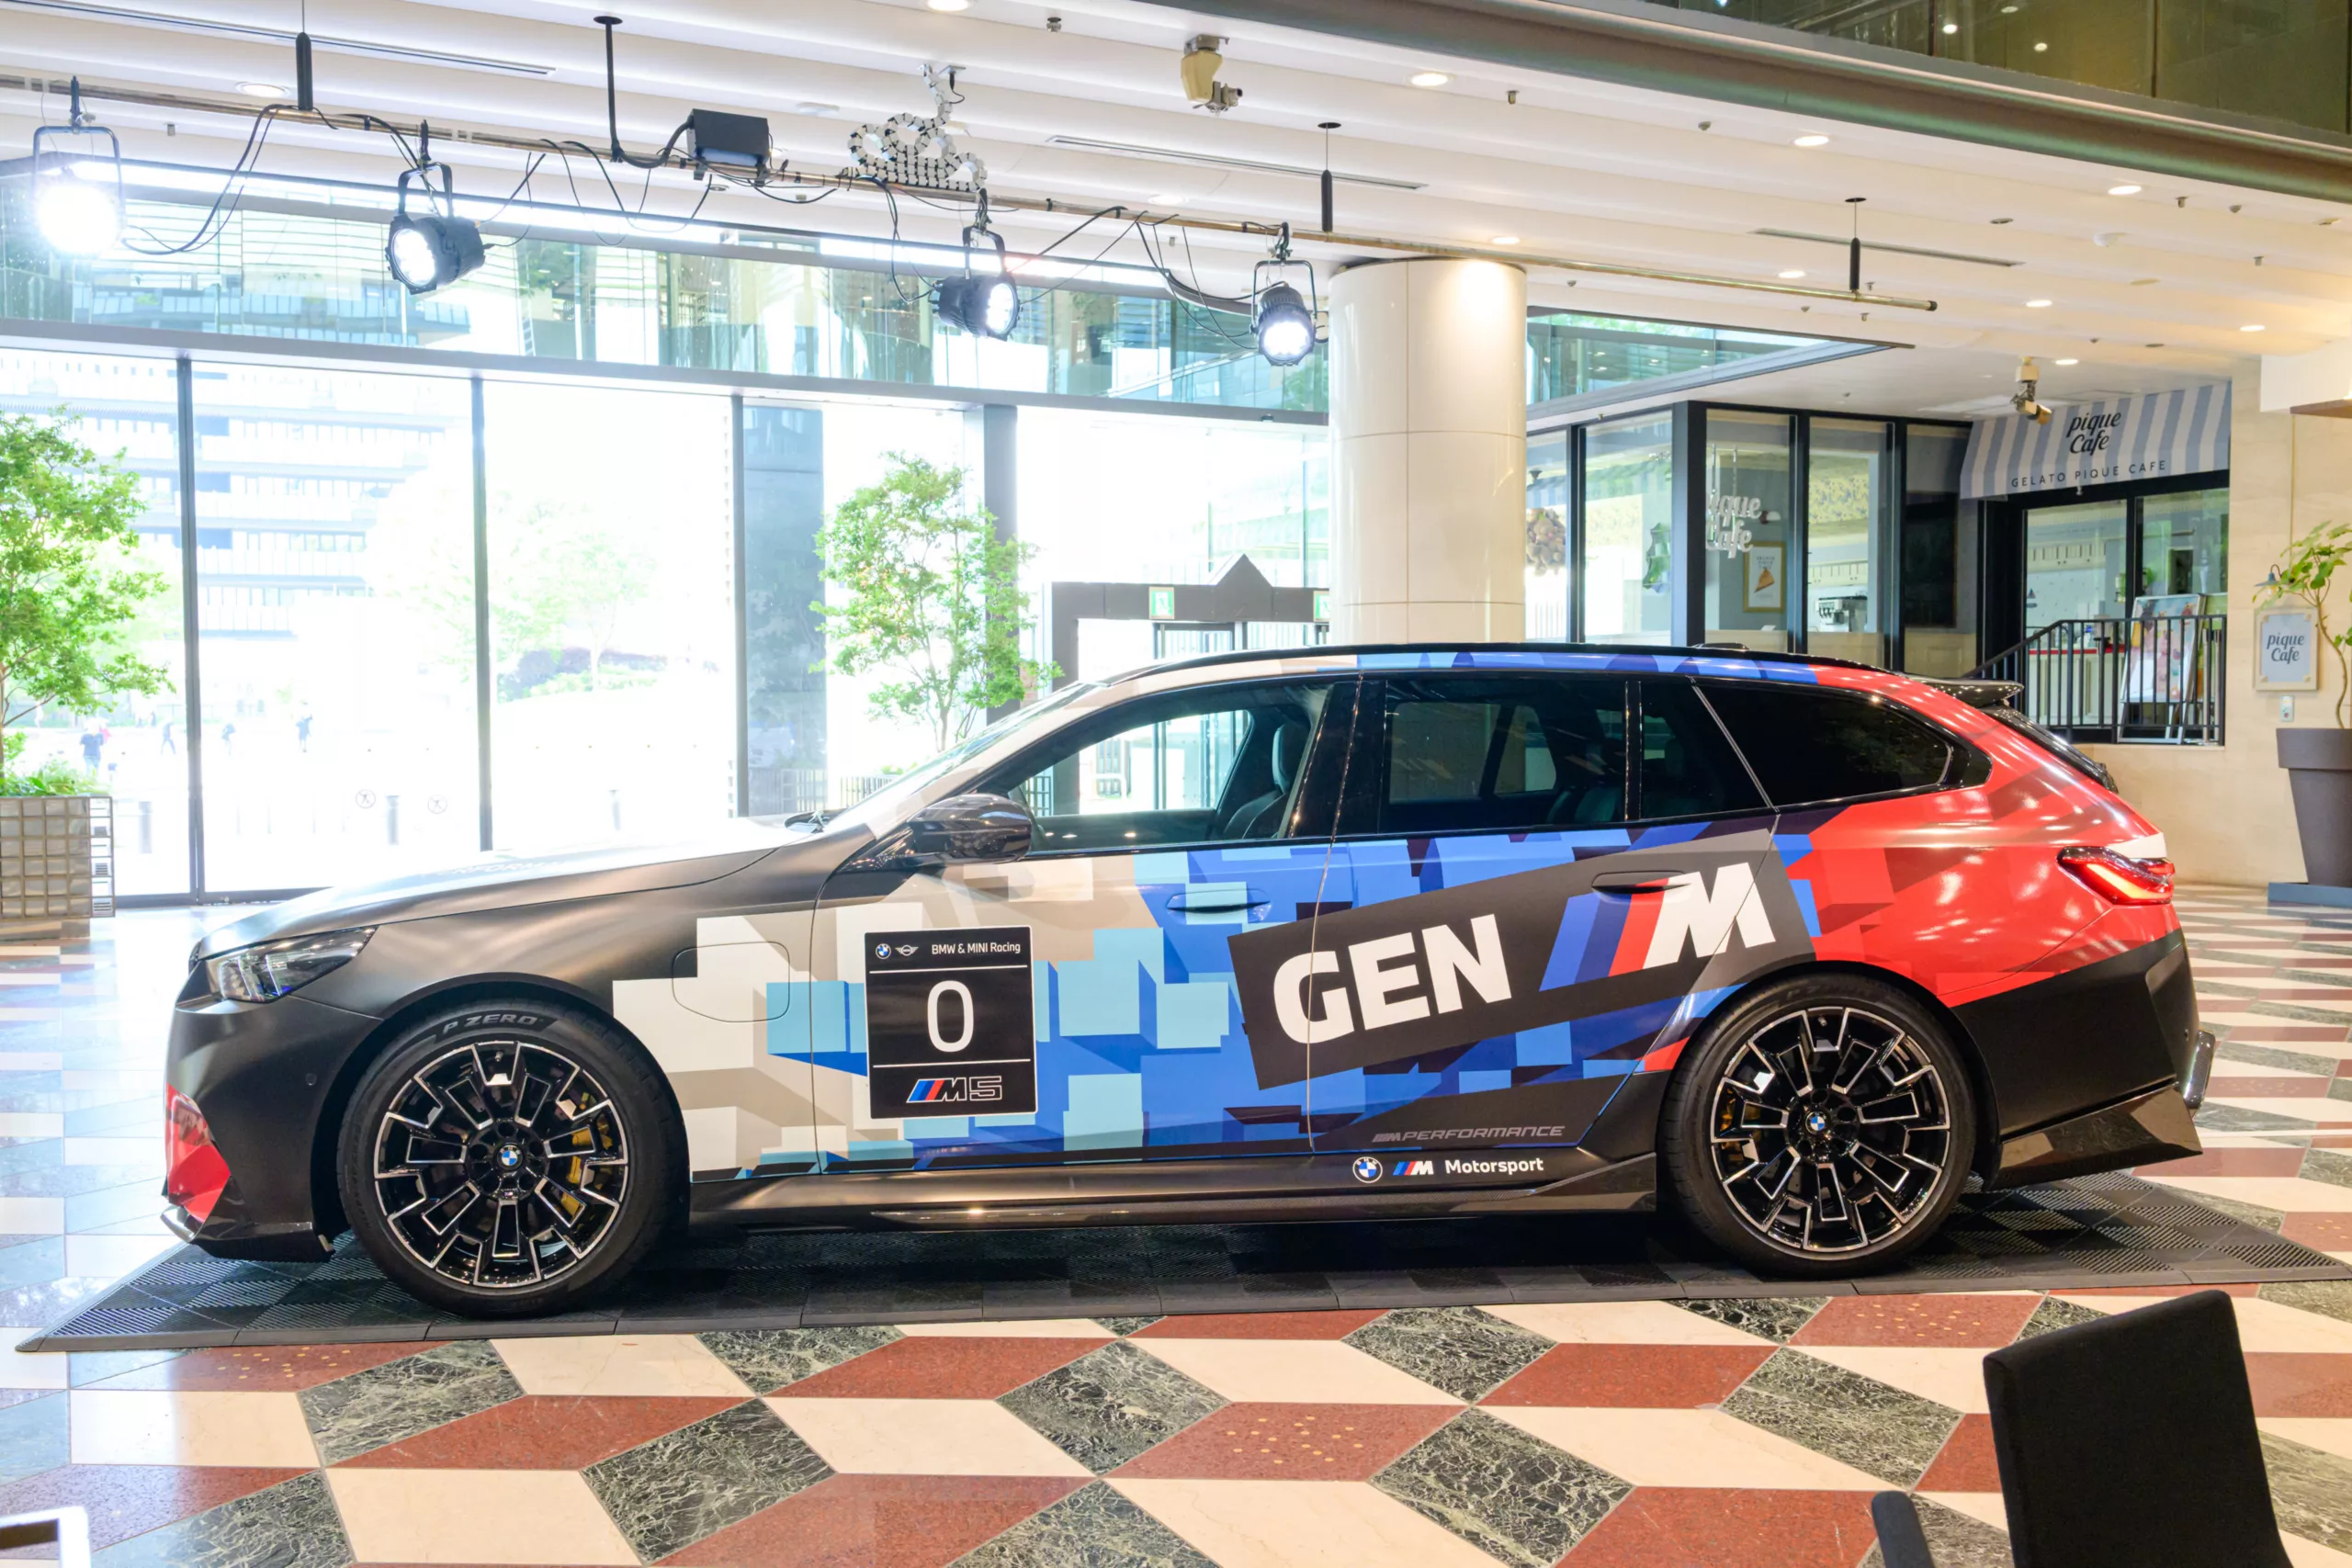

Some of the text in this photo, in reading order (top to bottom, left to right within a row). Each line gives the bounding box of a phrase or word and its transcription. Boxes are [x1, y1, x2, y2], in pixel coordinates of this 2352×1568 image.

[2066, 412, 2121, 438] pique
[2069, 429, 2109, 456] Cafe
[2011, 460, 2165, 488] GELATO PIQUE CAFE
[1706, 489, 1761, 527] ique
[2266, 632, 2305, 649] pique
[2271, 646, 2300, 664] Cafe
[932, 942, 1021, 954] BMW & MINI Racing
[1273, 913, 1511, 1044] GEN
[443, 1014, 538, 1034] P ZERO
[927, 980, 974, 1053] 0
[935, 1076, 1002, 1102] M5
[1402, 1126, 1566, 1141] PERFORMANCE
[1444, 1157, 1544, 1175] Motorsport
